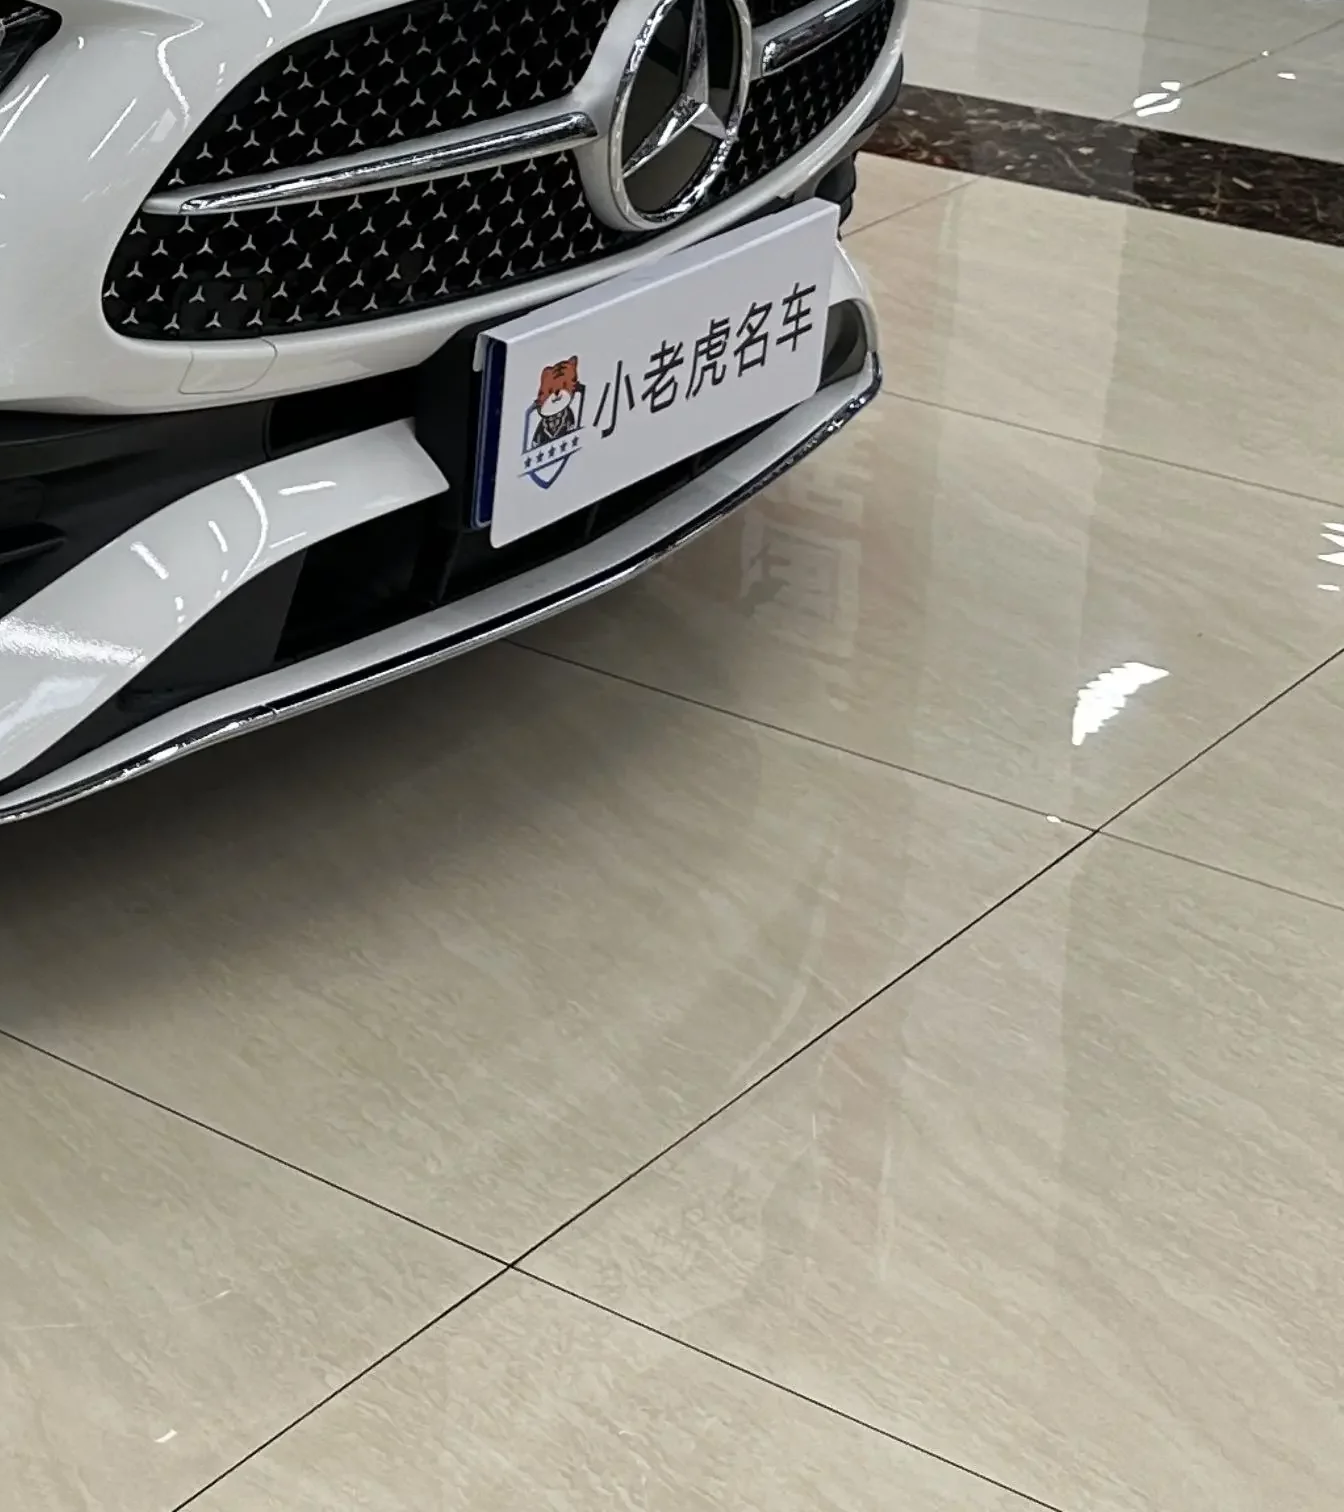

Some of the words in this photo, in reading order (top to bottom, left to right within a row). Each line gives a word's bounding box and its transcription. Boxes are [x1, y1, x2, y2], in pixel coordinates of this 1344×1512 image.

[593, 282, 817, 439] 小老虎名车
